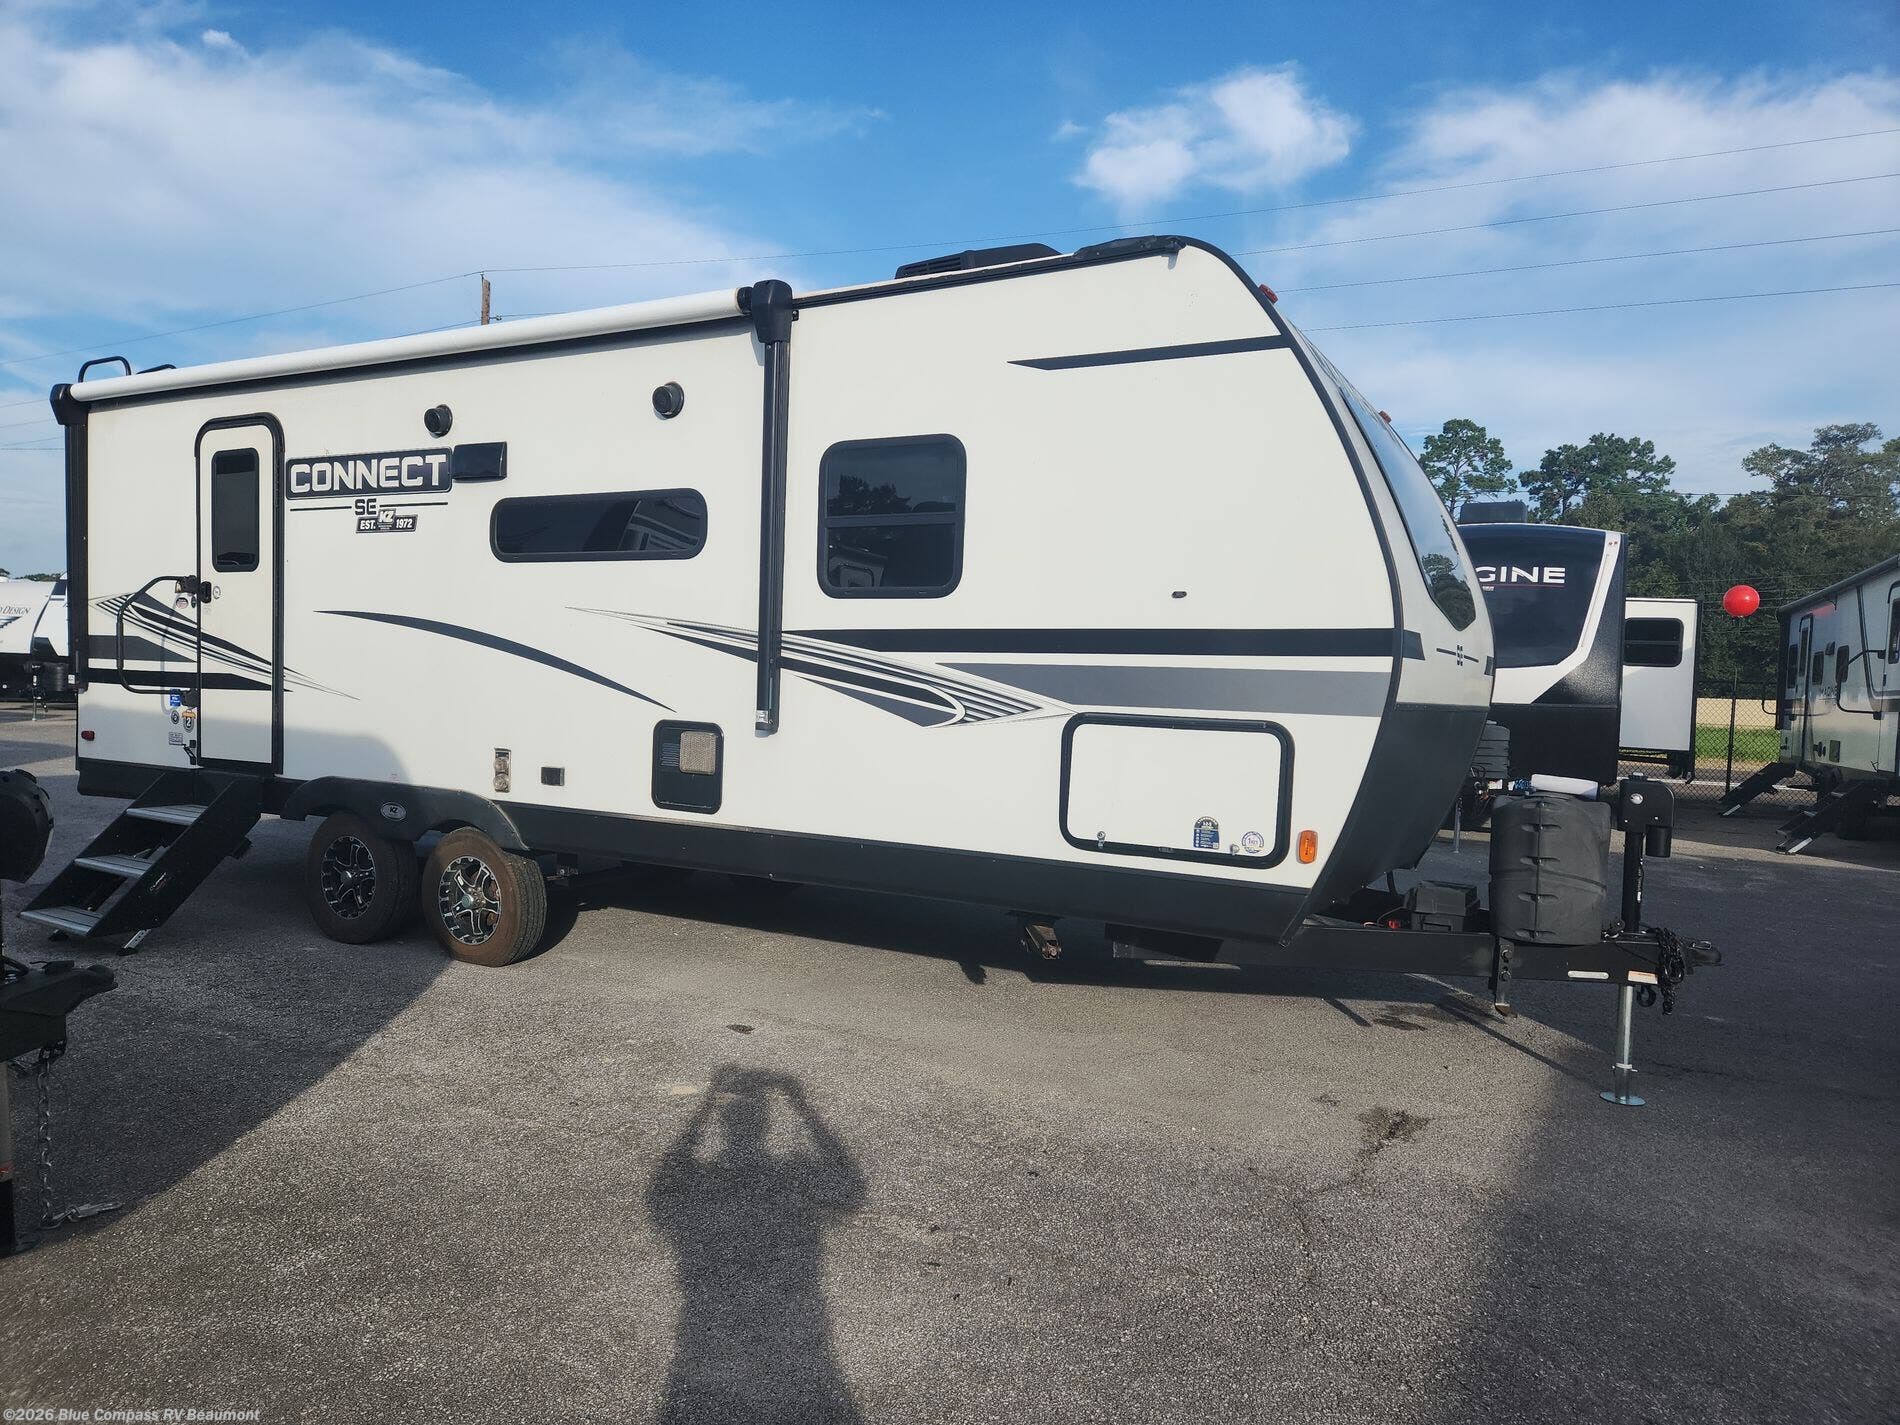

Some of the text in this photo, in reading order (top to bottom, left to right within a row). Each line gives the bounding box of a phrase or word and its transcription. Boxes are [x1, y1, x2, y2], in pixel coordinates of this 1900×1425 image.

[290, 454, 447, 494] CONNECT
[354, 498, 377, 516] SE
[359, 520, 376, 530] EST.
[396, 518, 413, 529] 1972
[1475, 566, 1565, 584] GINE
